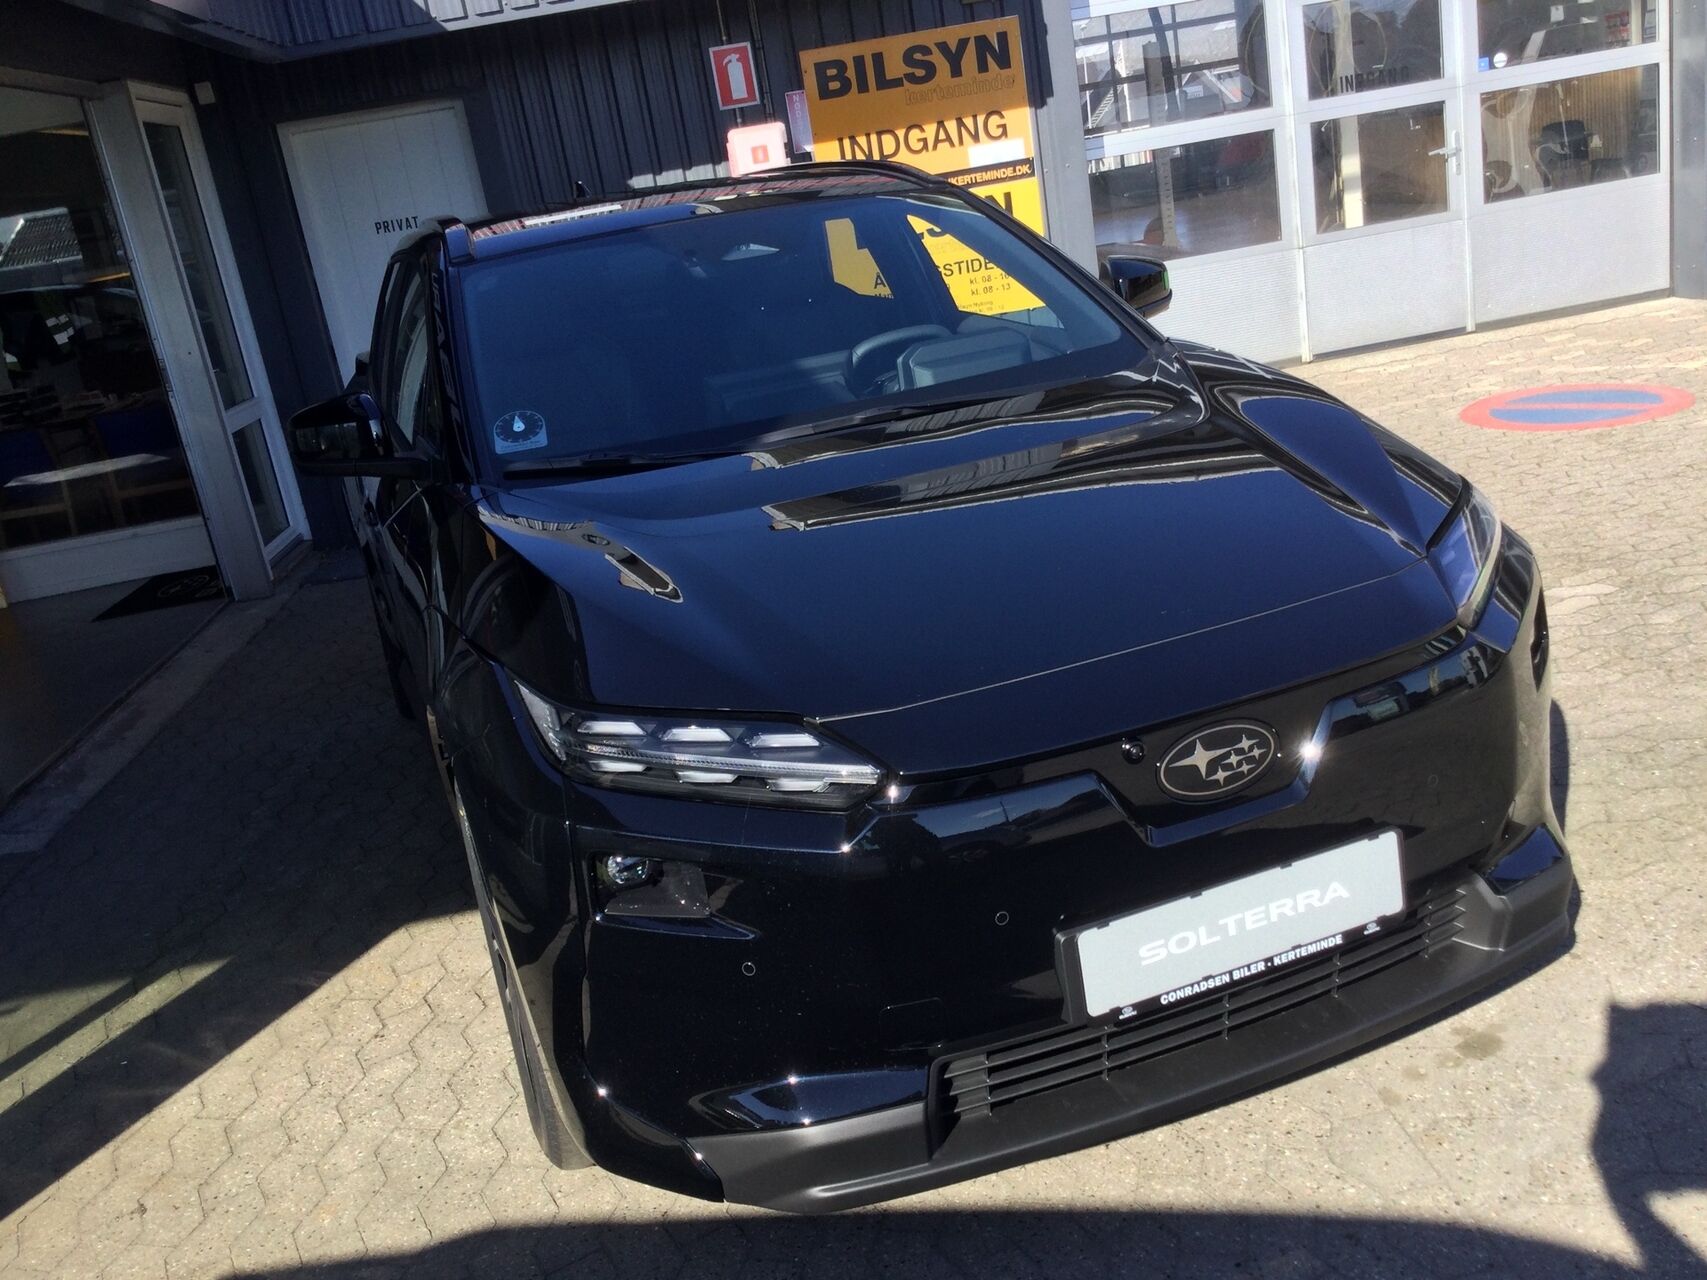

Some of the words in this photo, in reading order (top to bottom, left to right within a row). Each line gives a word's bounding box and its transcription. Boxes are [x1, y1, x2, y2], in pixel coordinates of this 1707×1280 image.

[813, 30, 1012, 101] BILSYN
[837, 110, 1009, 161] INDGANG
[948, 164, 1031, 185] KERTEMINDE.DK
[374, 216, 418, 235] PRIVAT
[937, 258, 995, 277] STIDE
[1138, 881, 1350, 966] SOLTERRA
[1160, 973, 1230, 1005] CONRADSEN
[1232, 961, 1266, 981] BILER
[1273, 934, 1343, 966] KERTEMINDE
